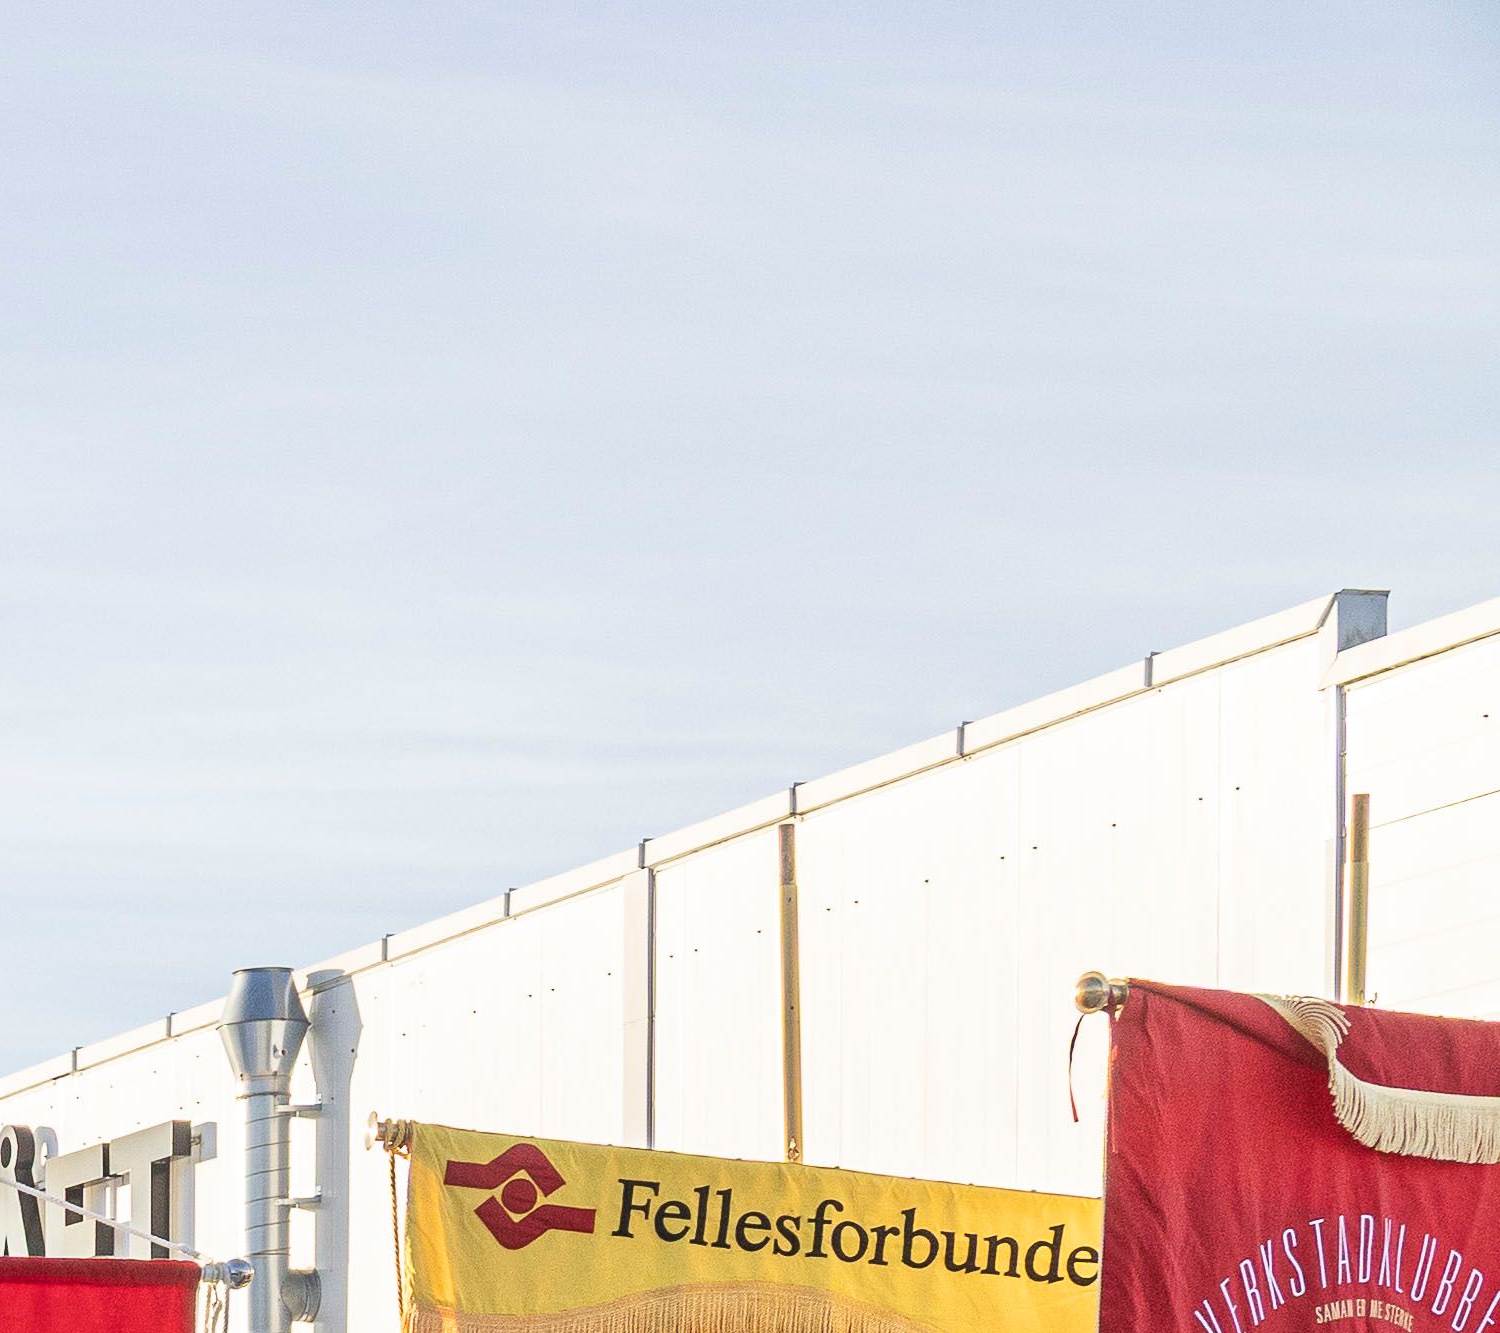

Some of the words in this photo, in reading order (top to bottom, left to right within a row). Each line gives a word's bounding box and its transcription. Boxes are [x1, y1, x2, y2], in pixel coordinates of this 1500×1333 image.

[611, 1178, 1100, 1287] Fellesforbunde
[1315, 1298, 1354, 1324] SAMAN
[1384, 1303, 1414, 1333] STERKE
